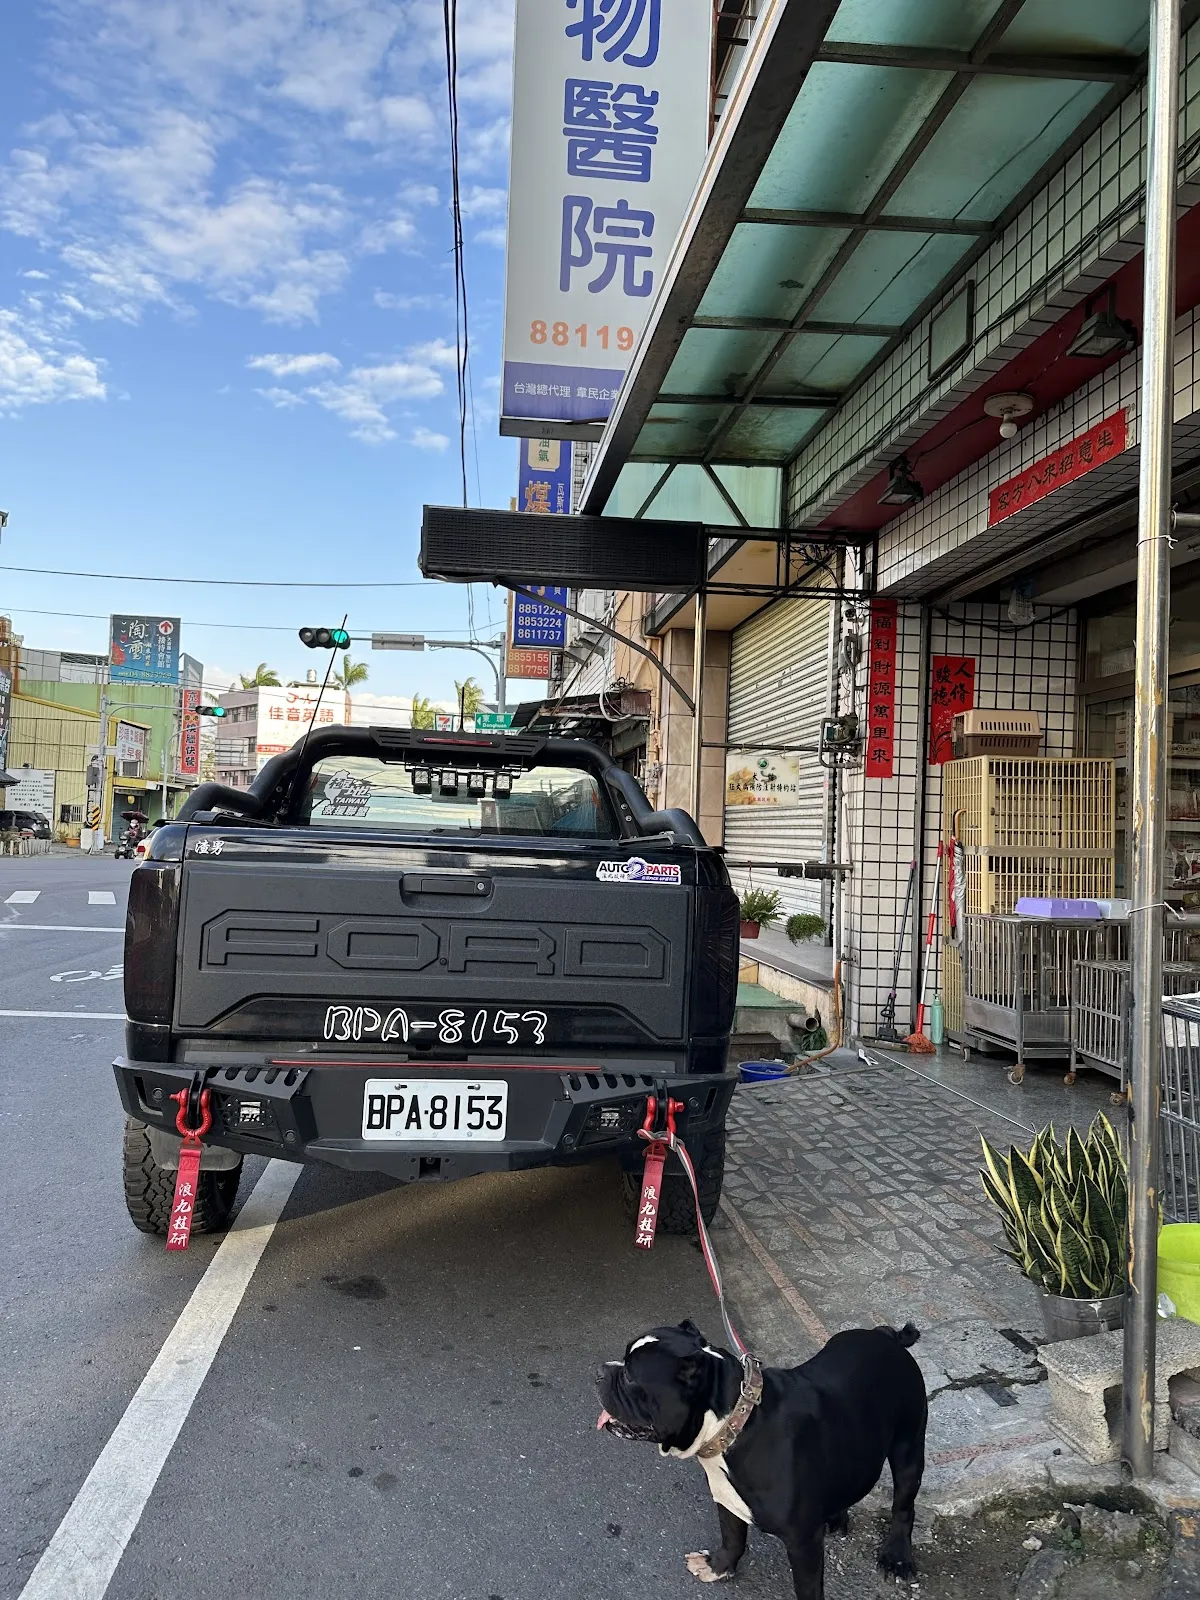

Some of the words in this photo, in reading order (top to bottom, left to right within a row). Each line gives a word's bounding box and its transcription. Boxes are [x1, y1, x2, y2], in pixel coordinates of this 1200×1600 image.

[560, 0, 661, 298] 物醫院
[529, 320, 634, 352] 88119
[513, 382, 571, 398] 台灣總代理
[518, 616, 563, 628] 8853224
[517, 628, 562, 640] 8611737
[508, 652, 549, 663] 8855155
[508, 664, 549, 675] 8817755
[870, 614, 893, 763] 福到財源萬里來
[269, 706, 334, 722] 佳音英語
[335, 797, 368, 805] TAIWAN
[195, 839, 225, 856] 渣男
[646, 865, 679, 876] PARTS
[205, 914, 669, 980] FORD
[323, 1004, 549, 1045] BPA-8153
